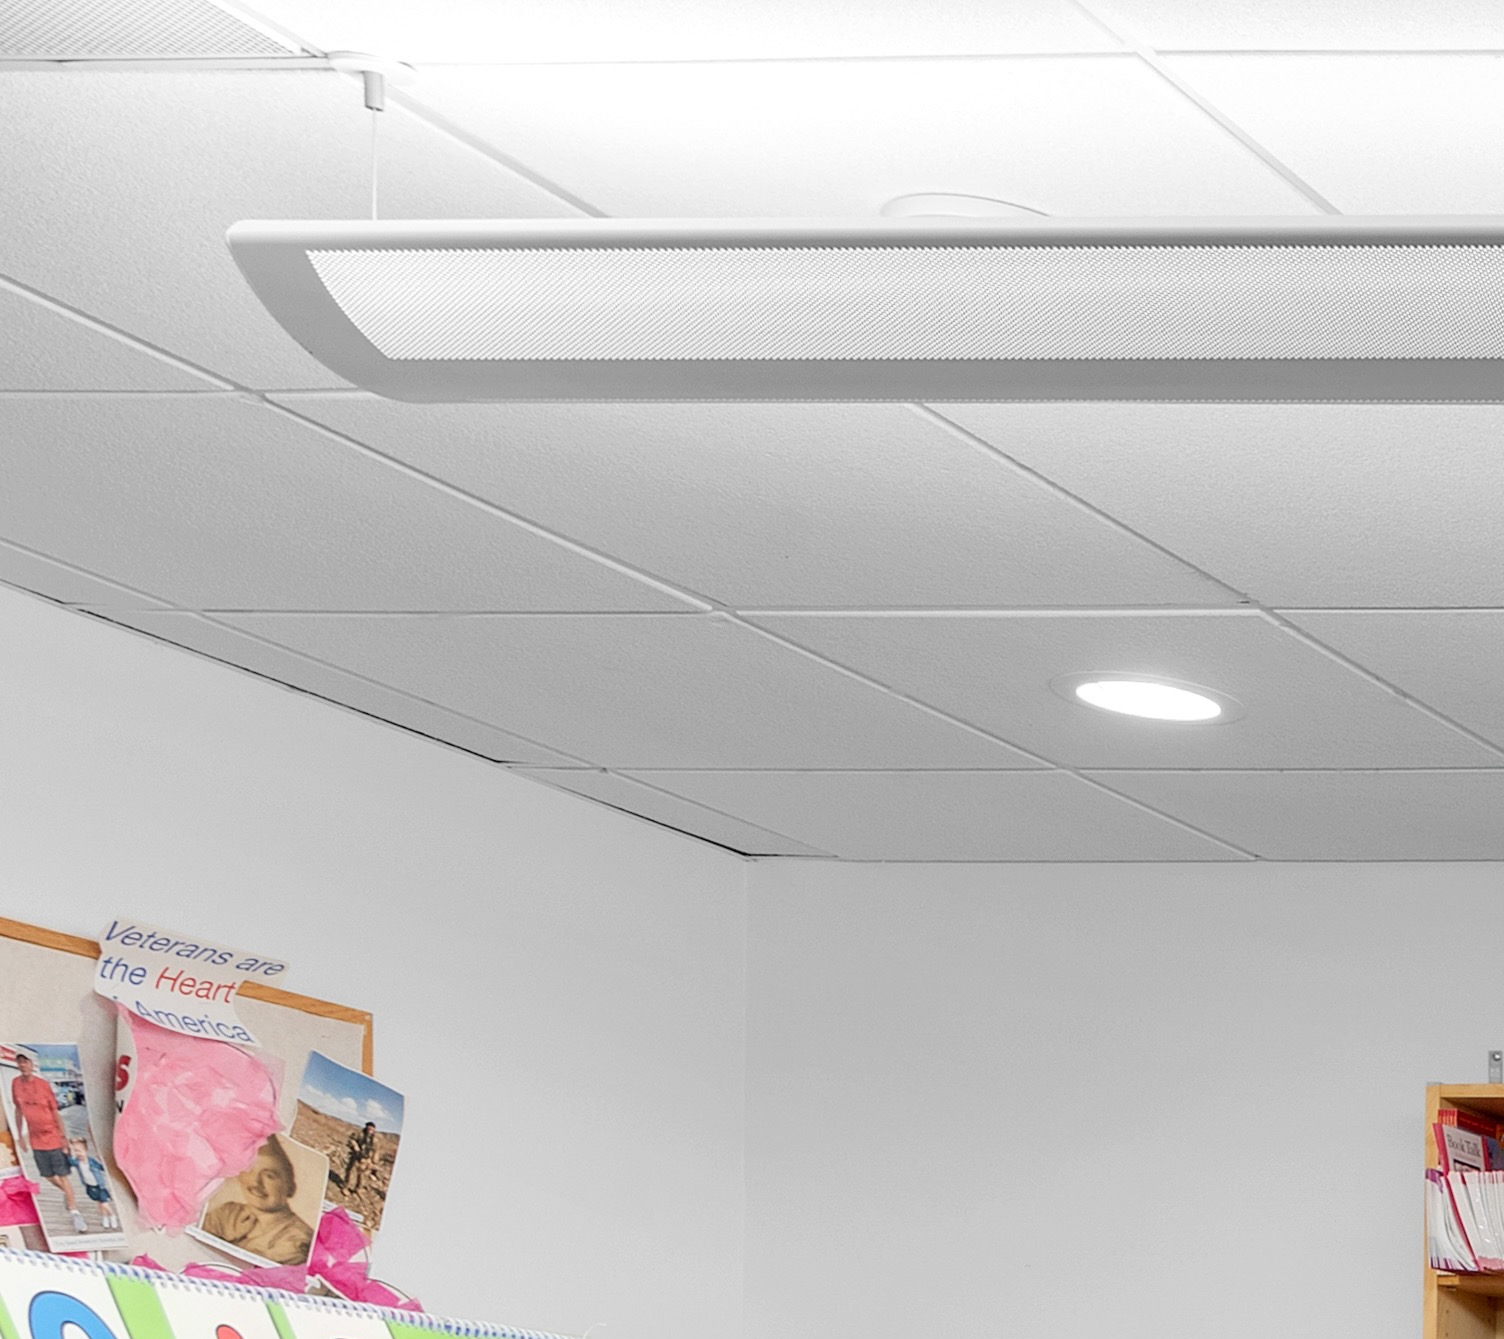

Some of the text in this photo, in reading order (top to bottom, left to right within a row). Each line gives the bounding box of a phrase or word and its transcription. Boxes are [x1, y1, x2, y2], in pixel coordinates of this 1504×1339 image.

[105, 921, 285, 977] Veterans are
[100, 956, 236, 1004] the Heart
[1446, 1133, 1482, 1157] Book Talk
